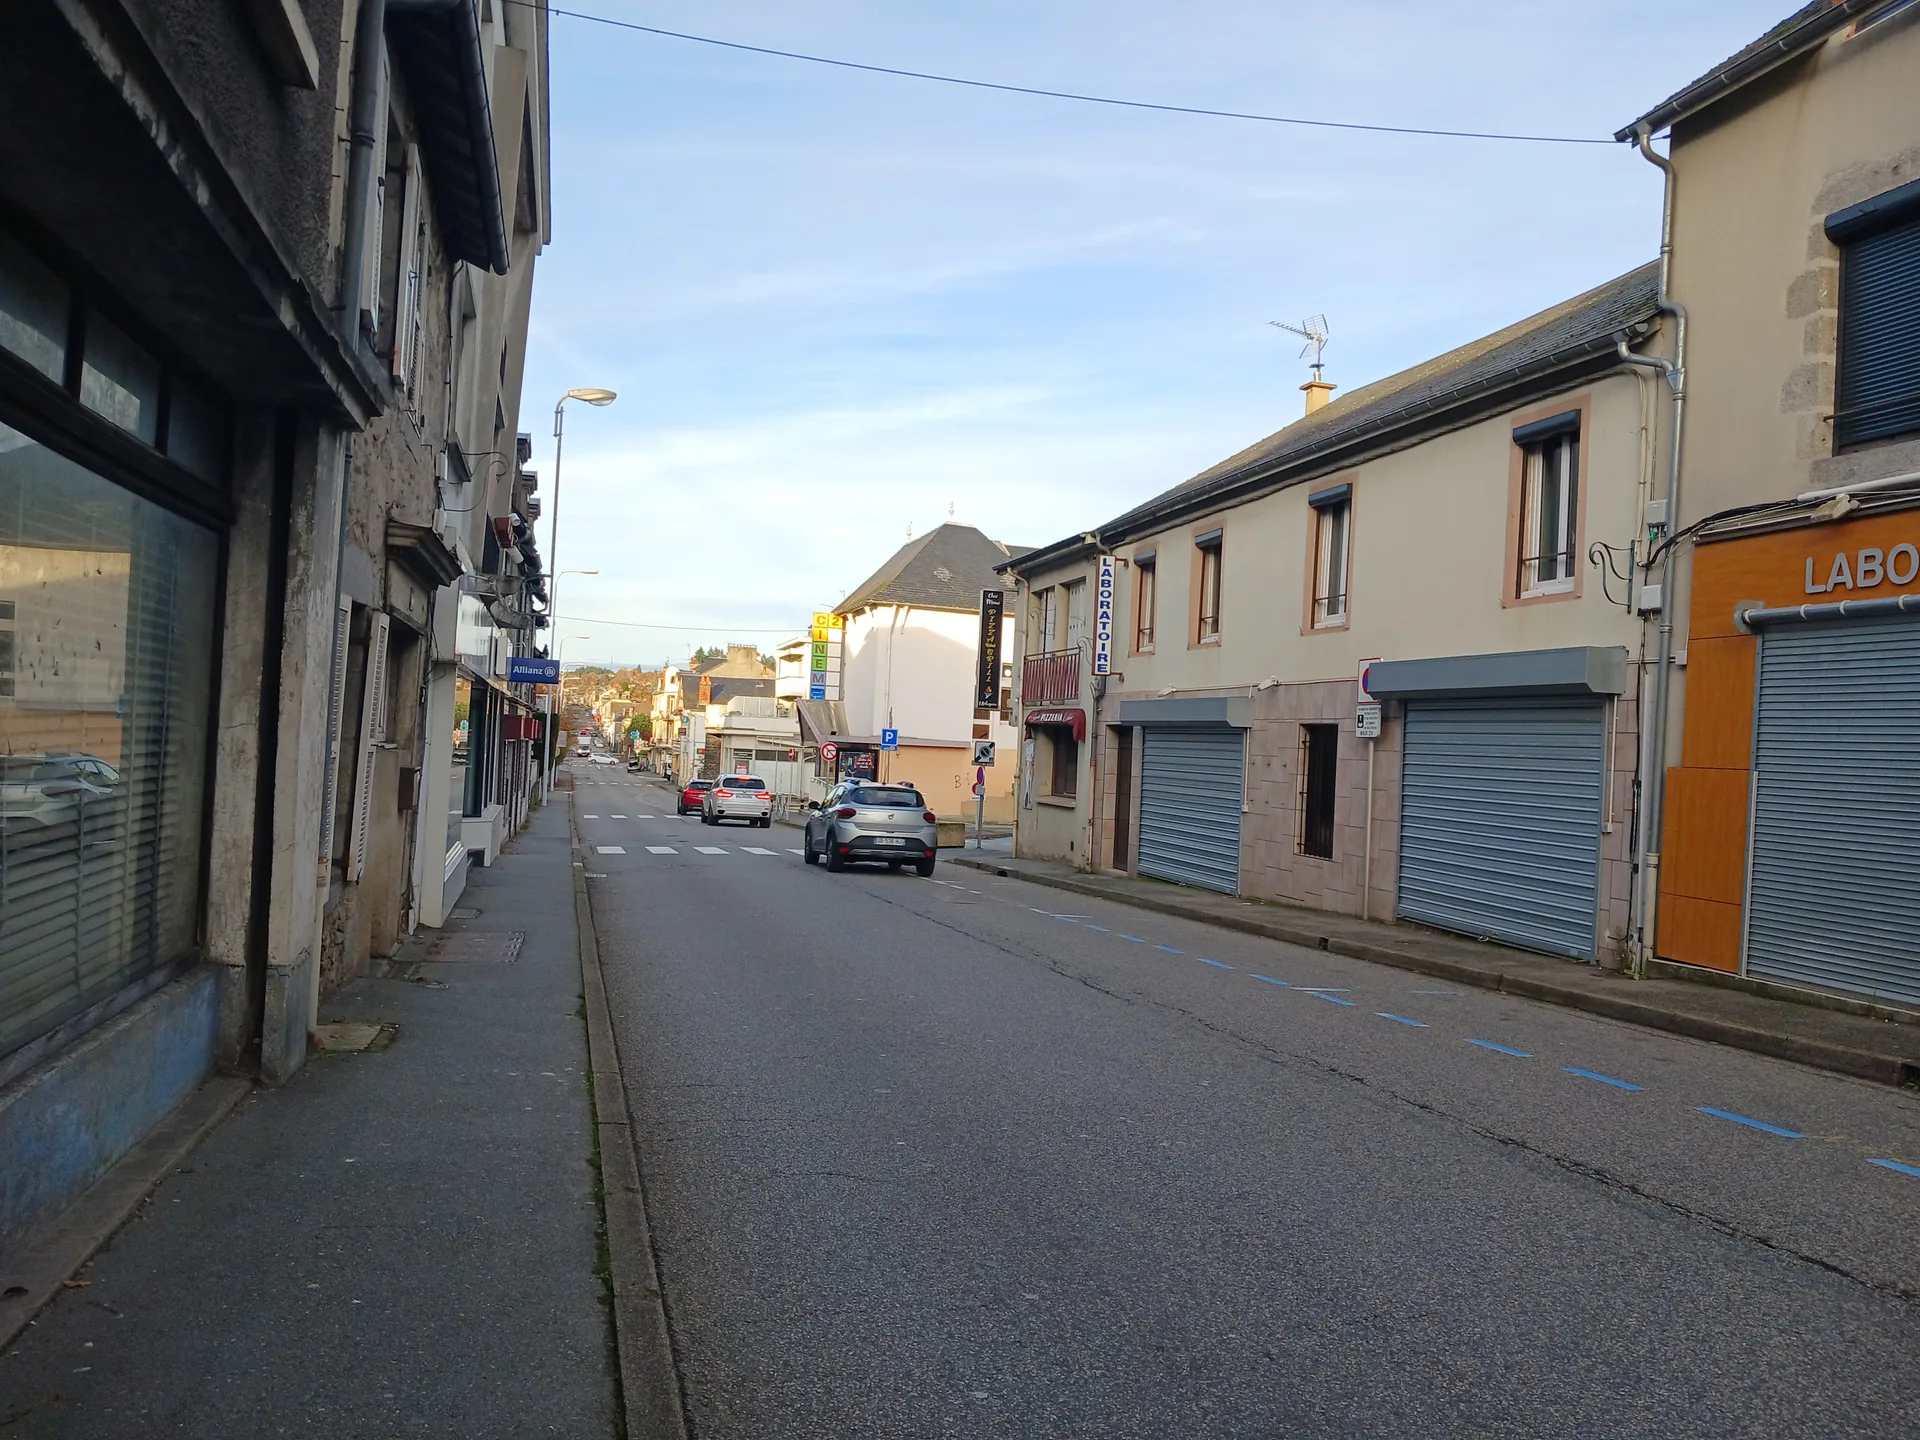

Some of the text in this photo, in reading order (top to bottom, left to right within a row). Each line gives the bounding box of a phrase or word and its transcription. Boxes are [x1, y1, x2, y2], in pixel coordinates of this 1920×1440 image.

[1805, 543, 1919, 594] LABO
[831, 616, 840, 627] 2
[986, 609, 997, 643] PIZZA
[1097, 557, 1112, 673] LABORATOIRE
[512, 665, 544, 675] Allianz
[986, 648, 995, 683] GRILL
[1040, 713, 1064, 722] PIZZERIA
[885, 731, 894, 743] P
